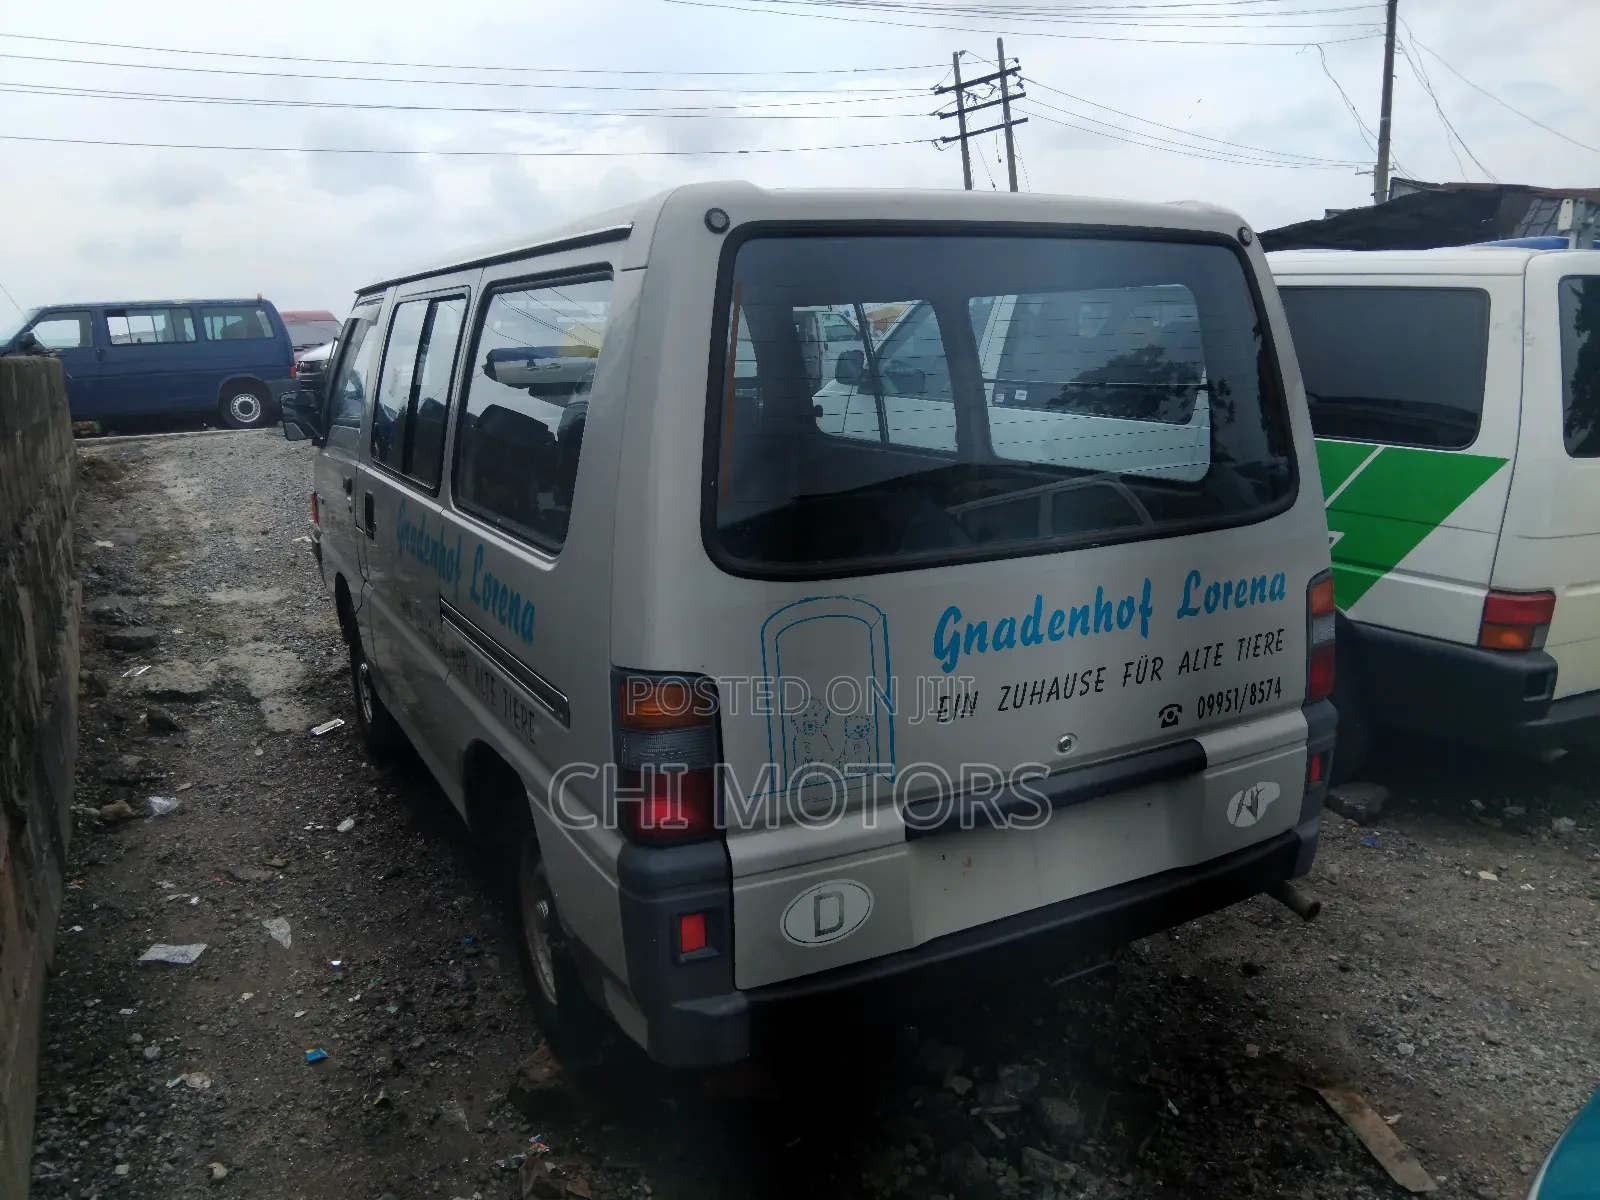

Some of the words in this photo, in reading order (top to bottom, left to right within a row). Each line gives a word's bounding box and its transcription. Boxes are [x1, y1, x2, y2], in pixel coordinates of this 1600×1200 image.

[470, 543, 535, 646] Lorena
[933, 577, 1153, 673] Gnadenhof
[1177, 569, 1286, 620] Lorena
[474, 662, 497, 707] ALTE
[503, 688, 535, 745] TIERE
[937, 690, 978, 723] EIN
[997, 667, 1106, 712] ZUHAUSE
[1122, 655, 1164, 688] FÜR
[1178, 642, 1223, 676] ALTE
[1237, 629, 1285, 662] TIERE
[1197, 676, 1282, 720] 09951/8574
[814, 889, 844, 938] D
